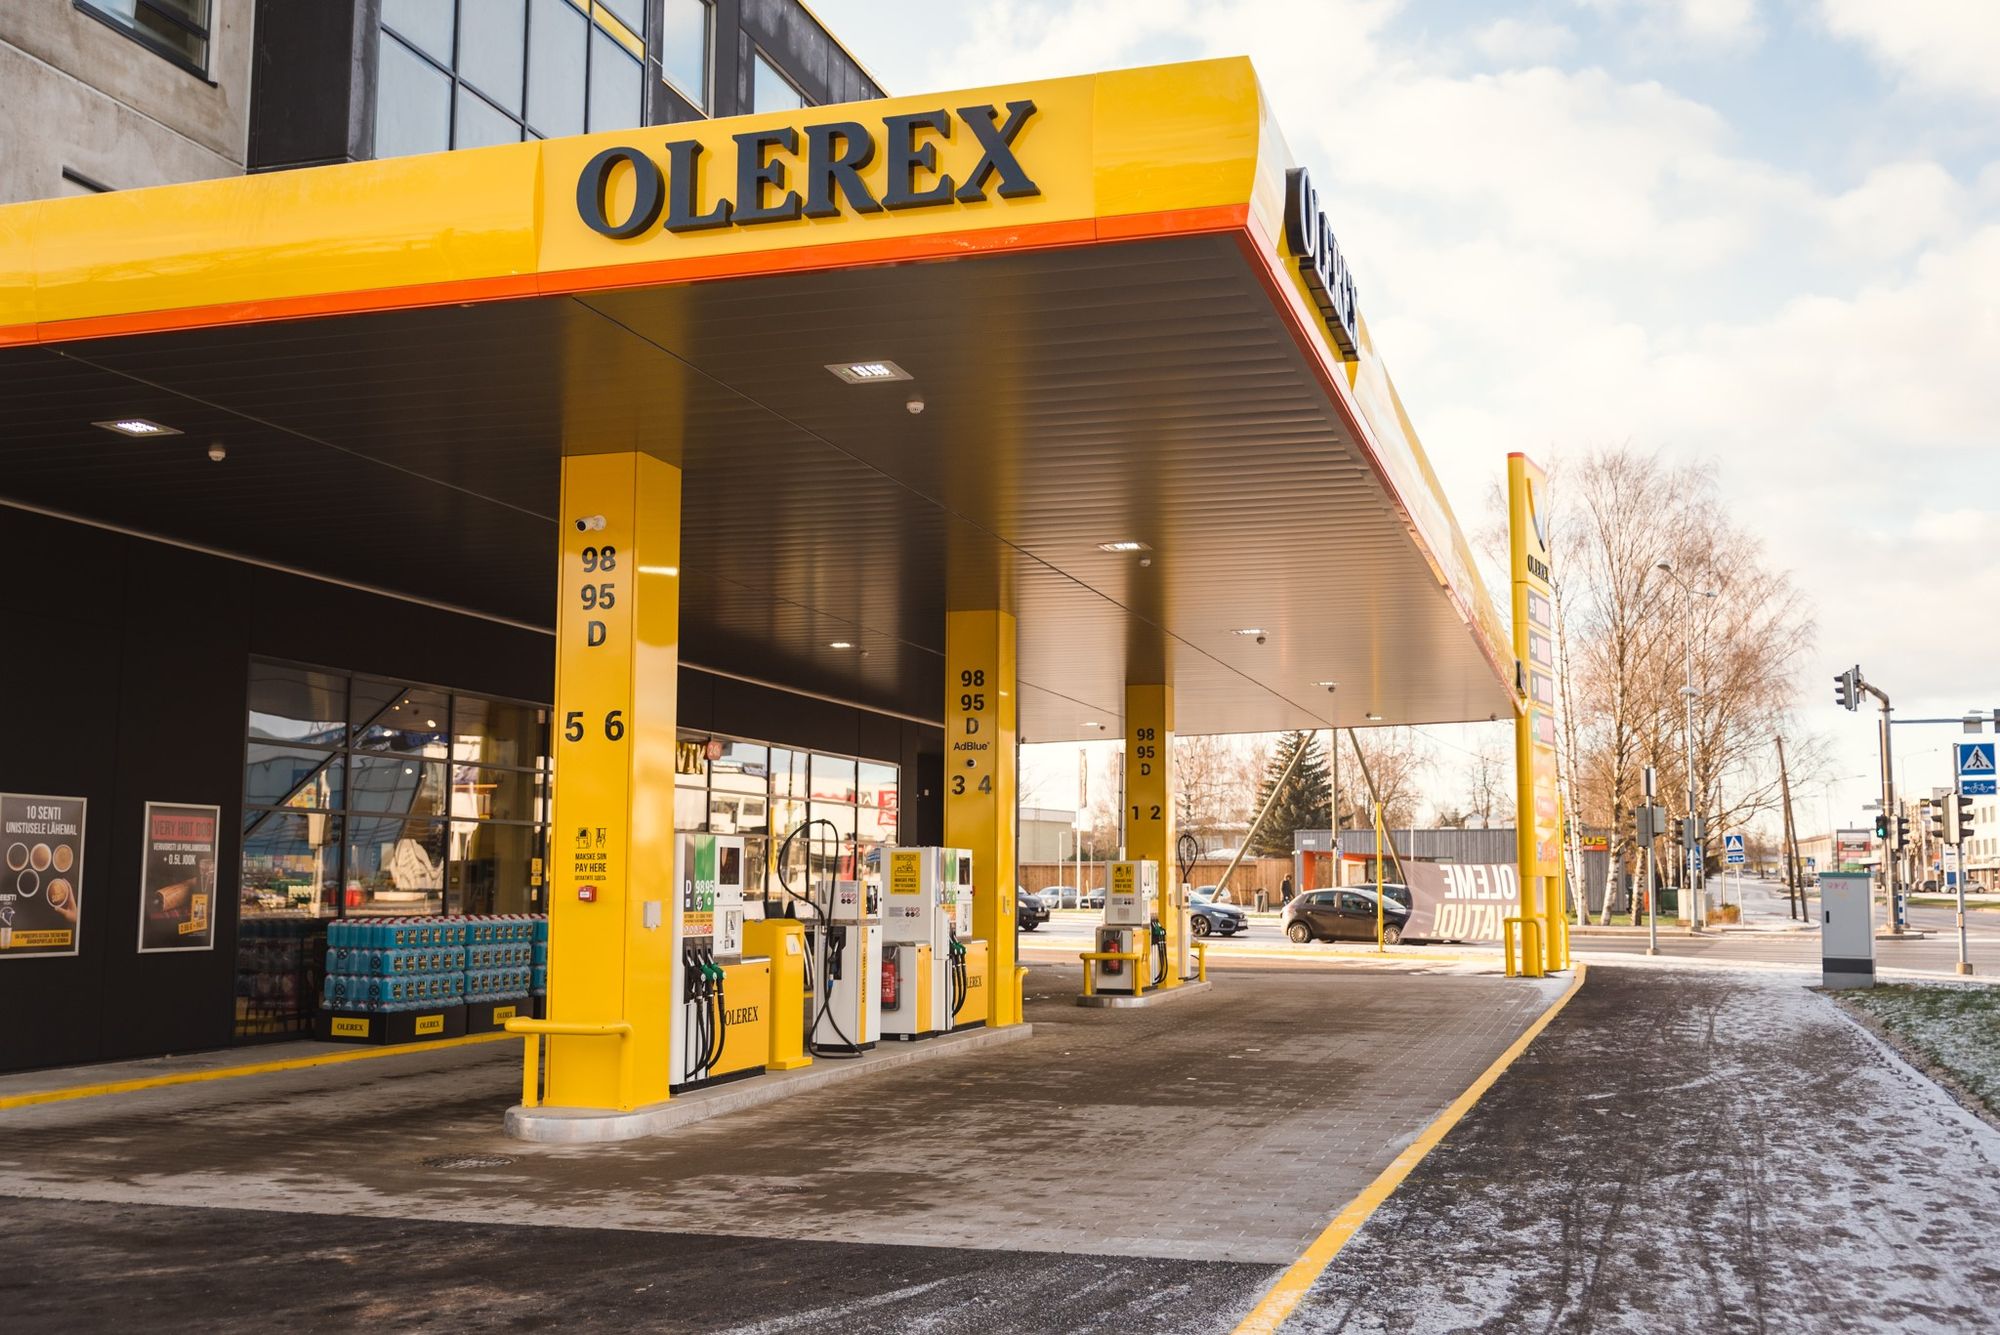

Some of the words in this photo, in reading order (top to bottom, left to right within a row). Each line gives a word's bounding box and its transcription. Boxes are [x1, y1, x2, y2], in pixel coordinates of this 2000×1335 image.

[576, 99, 1042, 240] OLEREX
[581, 545, 616, 573] 98
[580, 583, 616, 610] 95
[587, 620, 607, 647] D
[961, 669, 985, 687] 98
[960, 694, 985, 711] 95
[564, 711, 584, 742] 5
[604, 710, 625, 741] 6
[966, 717, 979, 735] D
[1136, 728, 1155, 741] 98
[1136, 746, 1155, 759] 95
[1141, 763, 1151, 776] D
[952, 775, 965, 795] 3
[978, 775, 992, 795] 4
[27, 805, 37, 819] 10
[38, 806, 61, 820] SENTI
[1132, 805, 1139, 820] 1
[1150, 805, 1161, 820] 2
[6, 821, 46, 834] UNISTUSELE
[47, 821, 77, 835] LÄHEMAL
[154, 819, 176, 835] VERY
[178, 820, 193, 837] HOT
[182, 855, 196, 865] JOOK
[575, 862, 588, 873] PAY
[589, 863, 607, 873] HERE
[685, 880, 692, 894] D
[695, 880, 705, 894] 98
[705, 880, 714, 894] 95
[966, 975, 982, 989] LEREX
[725, 1005, 759, 1026] OLEREX
[336, 1023, 363, 1032] OLEREX
